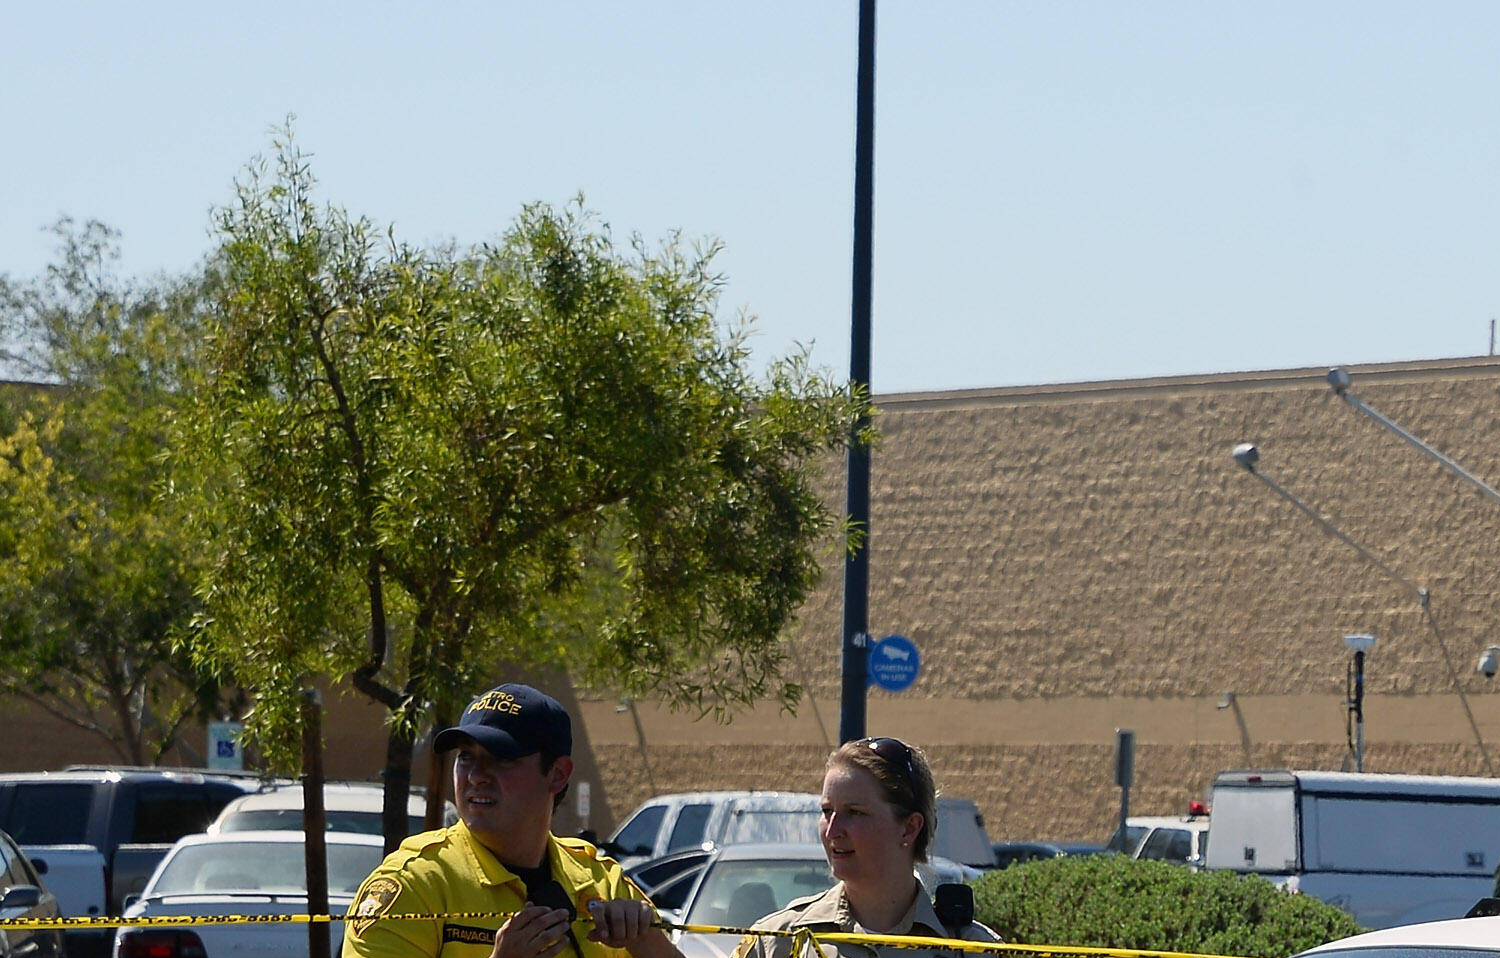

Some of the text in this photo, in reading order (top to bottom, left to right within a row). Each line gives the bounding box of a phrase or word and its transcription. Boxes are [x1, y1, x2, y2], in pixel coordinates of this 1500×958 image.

[853, 632, 866, 648] 41
[482, 690, 515, 701] TRO
[467, 697, 523, 716] POLICE
[446, 928, 498, 944] TRAVAGLI
